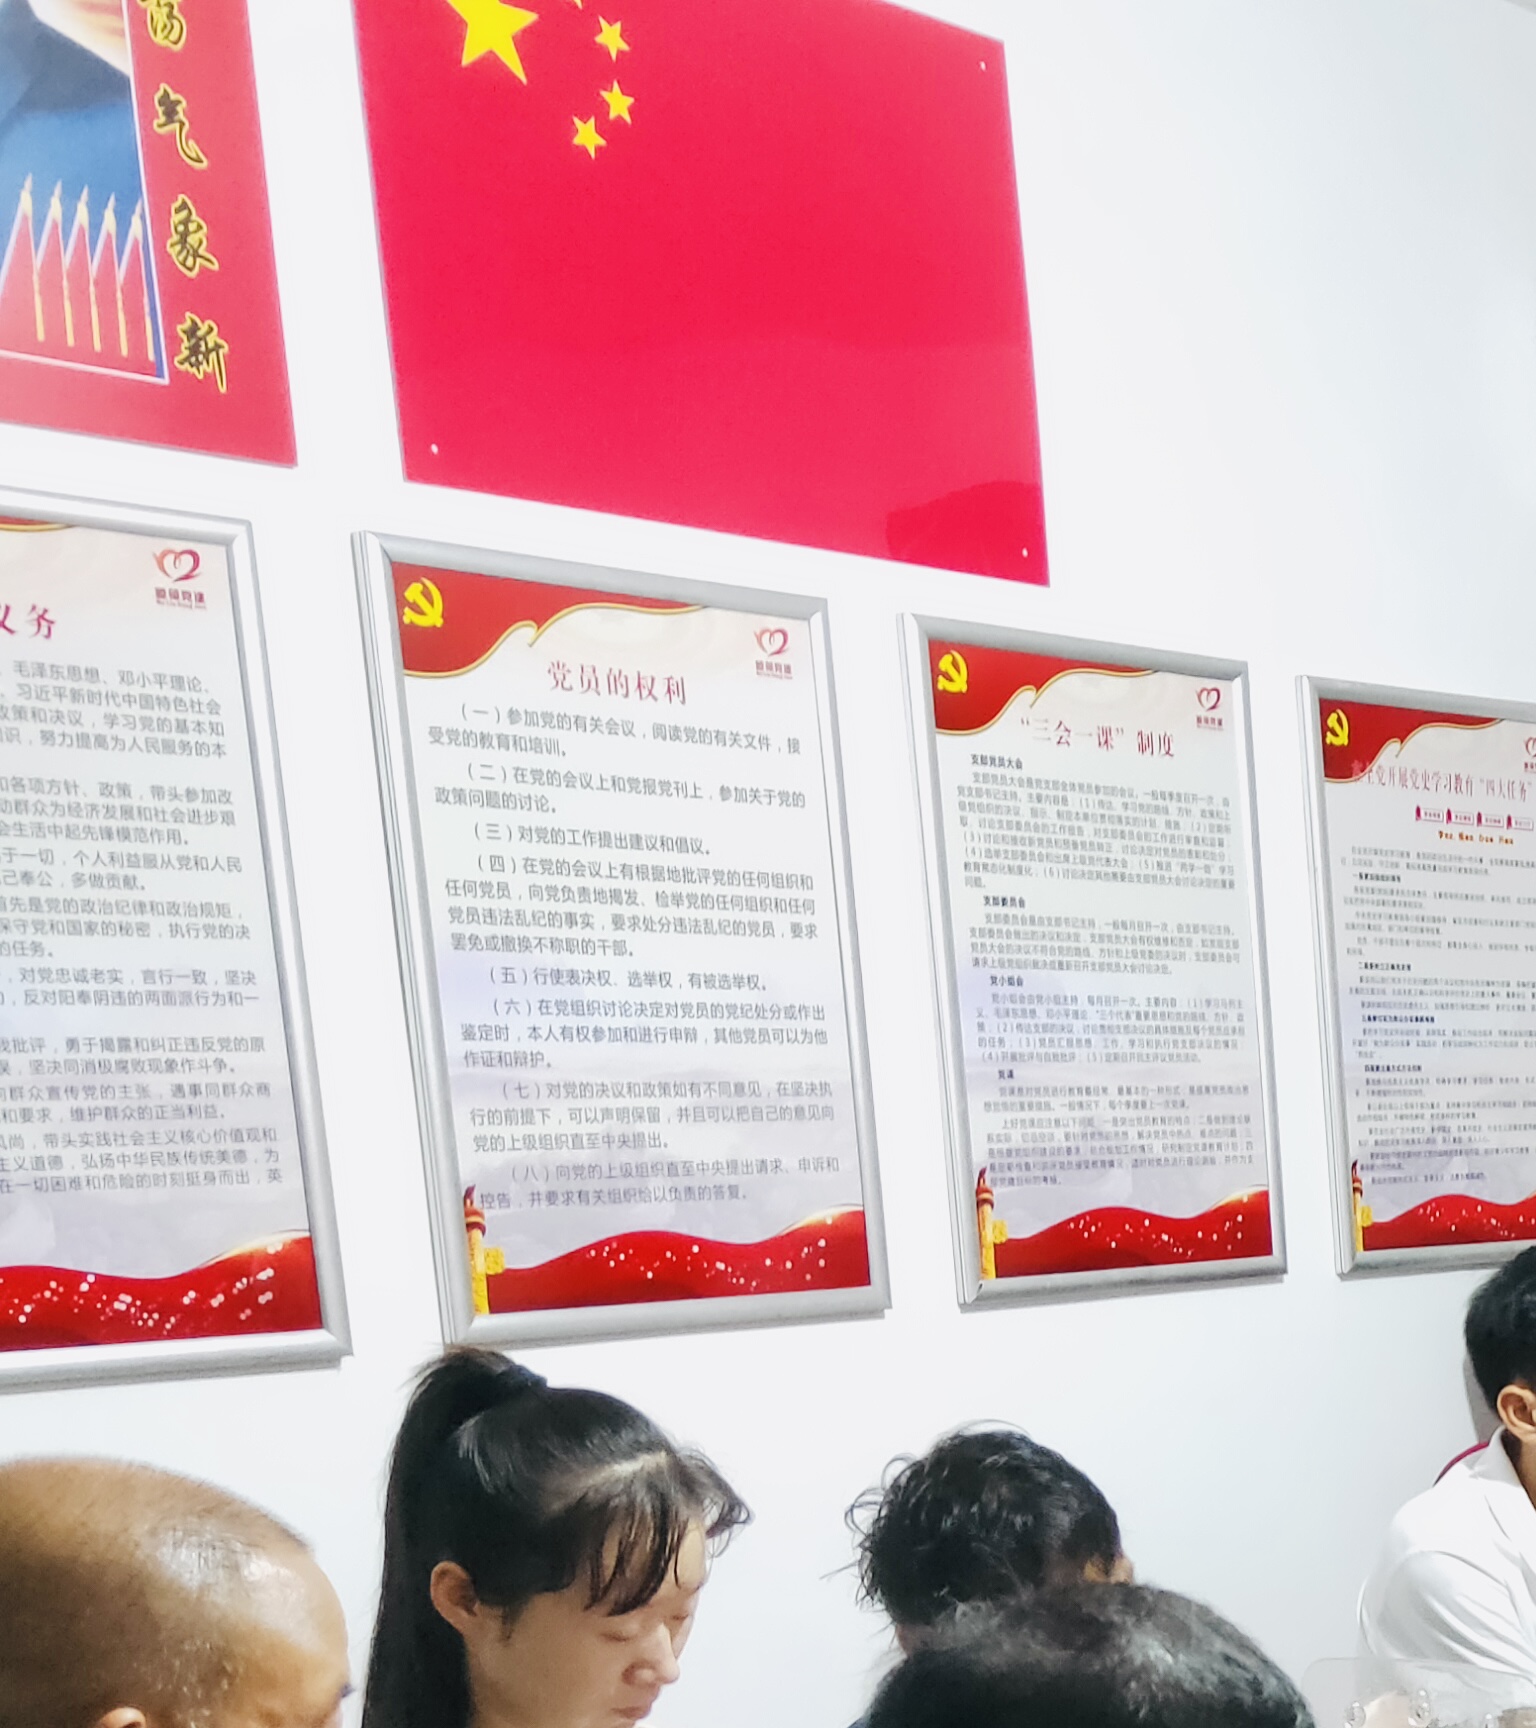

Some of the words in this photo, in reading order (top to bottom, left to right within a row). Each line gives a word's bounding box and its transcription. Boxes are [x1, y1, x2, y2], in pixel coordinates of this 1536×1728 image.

[546, 659, 686, 705] 党员的权利
[0, 723, 226, 760] 识，努力提高为人民服务的本
[0, 844, 242, 874] 于一切，个人利益服从党和人民
[0, 867, 145, 891] 己奉公，多做贡献。
[0, 964, 256, 987] ，对党忠诚老实，言行一致，坚决
[0, 987, 259, 1008] ，反对阳奉阴违的两面派行为和一
[0, 1103, 224, 1123] 和要求，维护群众的正当利益。
